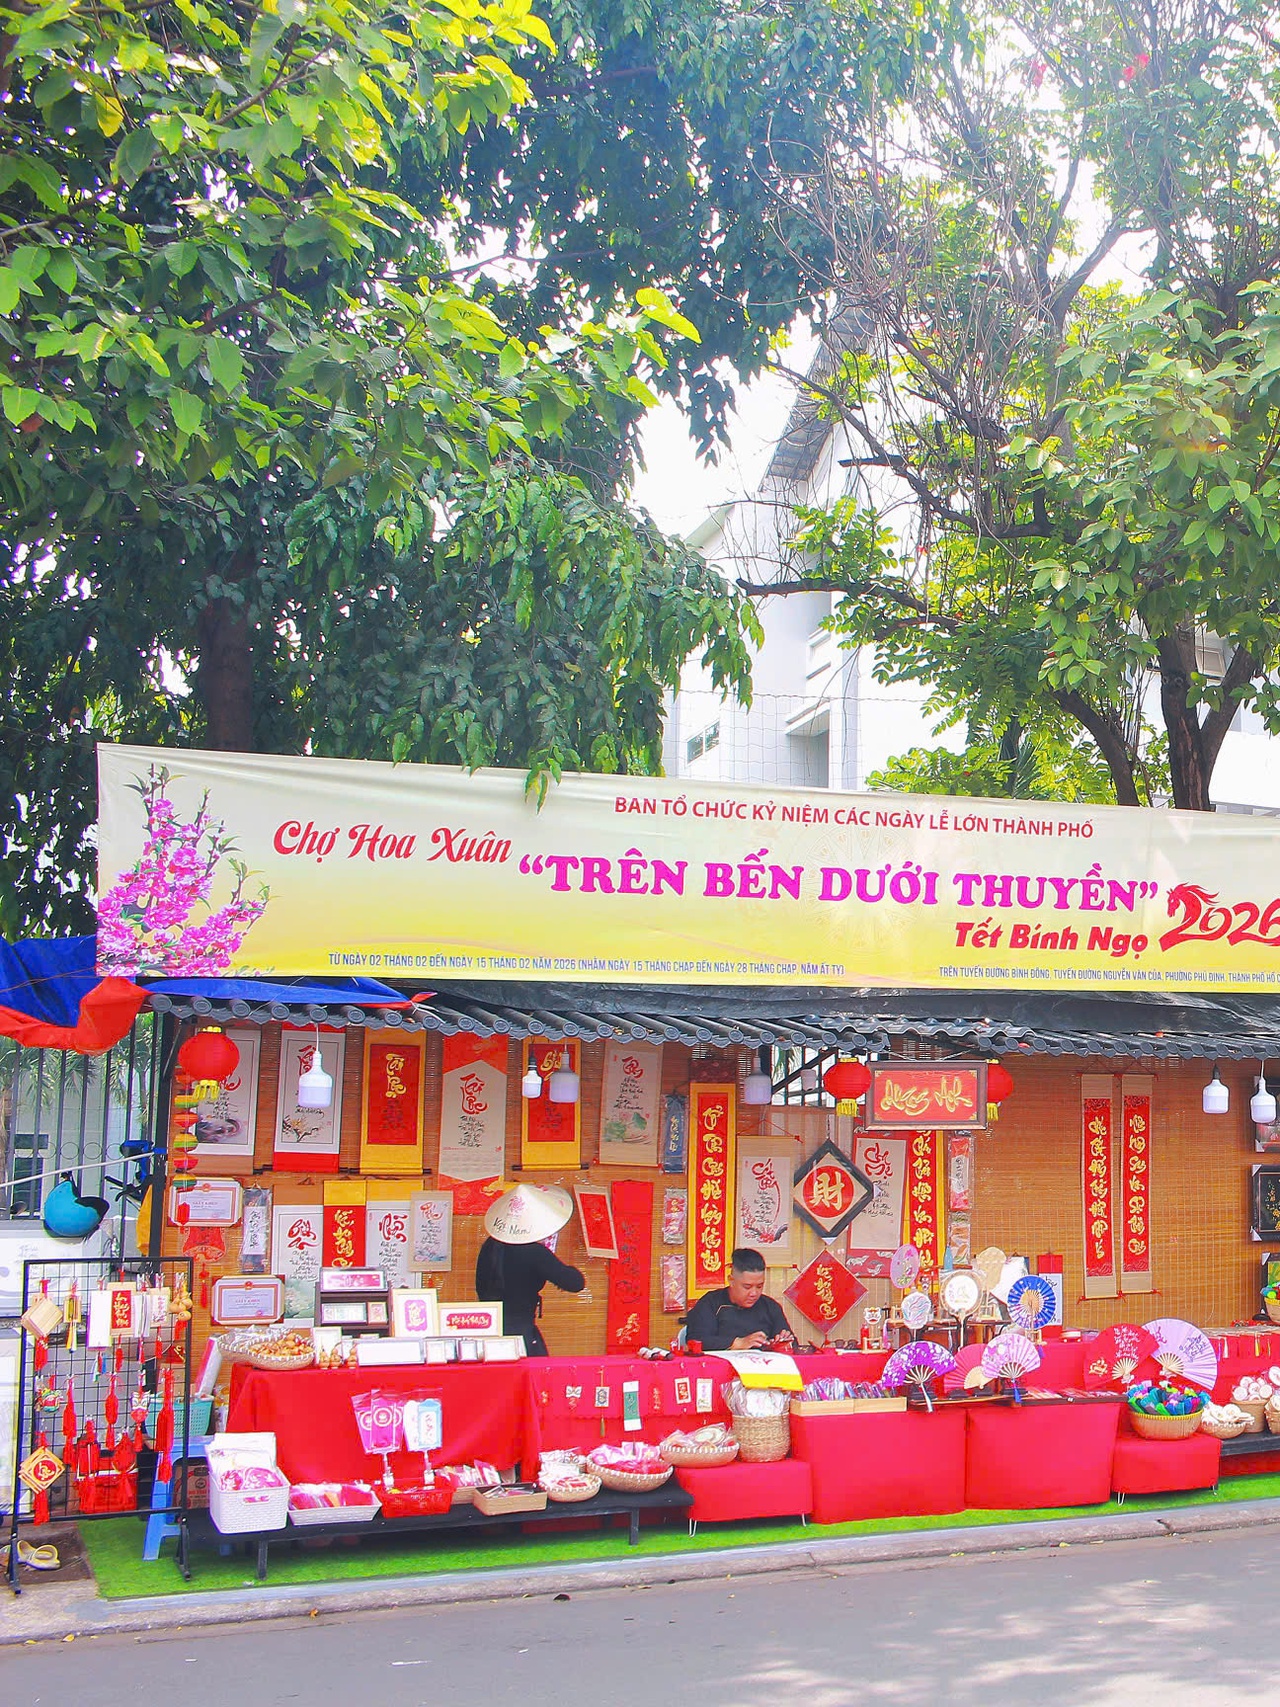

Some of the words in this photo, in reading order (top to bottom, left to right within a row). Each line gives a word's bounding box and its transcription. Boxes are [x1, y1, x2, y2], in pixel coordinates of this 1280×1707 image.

[615, 797, 657, 815] BAN
[661, 794, 687, 817] TỔ
[692, 800, 748, 820] CHỨC
[752, 801, 777, 821] KỶ
[781, 804, 829, 827] NIỆM
[834, 808, 870, 827] CÁC
[875, 811, 925, 829] NGÀY
[929, 809, 949, 831] LỄ
[953, 814, 989, 832] LỚN
[993, 818, 1053, 836] THÀNH
[1057, 818, 1094, 839] PHỐ
[273, 820, 340, 863] Chợ
[348, 824, 416, 862] Hoa
[428, 827, 513, 863] Xuân
[703, 849, 805, 898] BẾN
[818, 861, 938, 905] DƯỚI
[955, 920, 1003, 949] Tết
[1009, 922, 1079, 953] Bính
[1085, 926, 1149, 961] Ngọ
[329, 952, 341, 966] TỪ
[343, 953, 368, 966] NGÀY
[370, 956, 381, 966] 02
[384, 954, 413, 967] THÁNG
[416, 957, 428, 967] 02
[429, 954, 448, 968] ĐẾN
[450, 955, 473, 968] NGÀY
[477, 958, 487, 968] 15
[489, 956, 517, 969] THÁNG
[519, 959, 531, 969] 02
[533, 957, 552, 970] NĂM
[554, 960, 576, 970] 2026
[608, 959, 630, 971] NGÀY
[633, 961, 643, 971] 15
[645, 959, 672, 972] THÁNG
[714, 961, 735, 973] NGÀY
[737, 963, 748, 973] 28
[750, 962, 775, 974] THÁNG
[801, 963, 819, 975] NĂM
[939, 965, 958, 977] TRÊN
[960, 964, 984, 978] TUYẾN
[985, 966, 1009, 978] ĐƯỜNG
[1011, 966, 1029, 979] BÌNH
[1054, 966, 1077, 980] TUYẾN
[1078, 967, 1101, 980] ĐƯỜNG
[810, 1172, 846, 1211] 財
